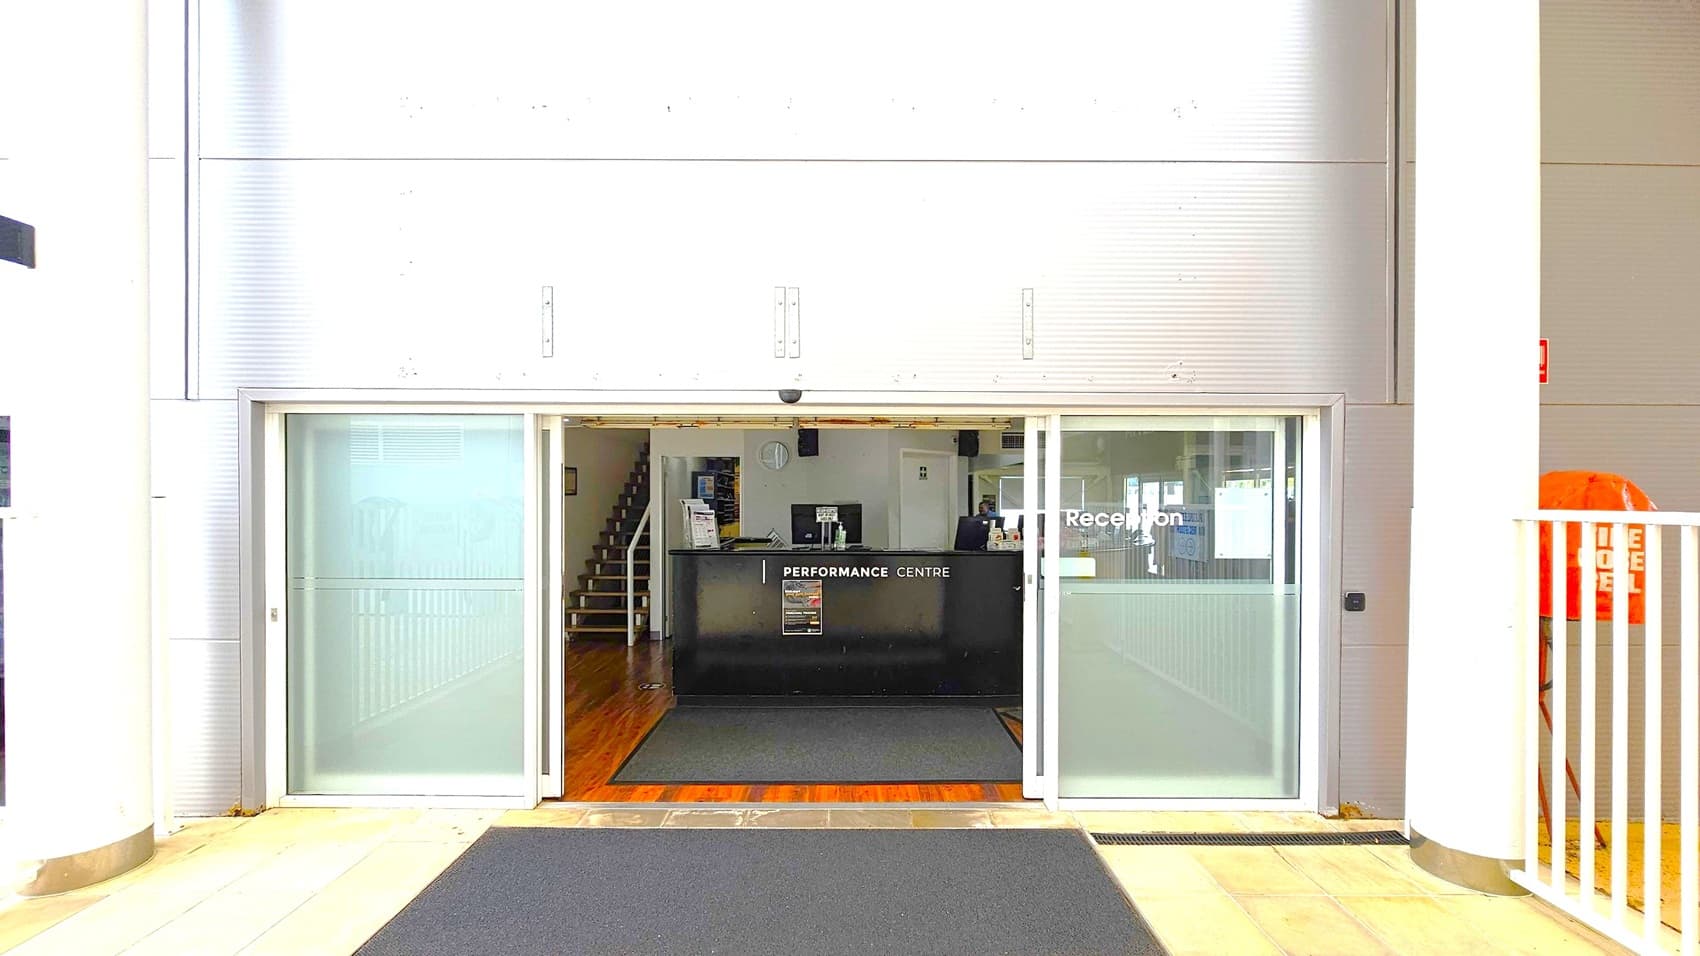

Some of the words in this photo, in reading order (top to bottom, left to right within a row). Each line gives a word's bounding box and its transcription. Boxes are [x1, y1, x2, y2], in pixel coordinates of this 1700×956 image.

[1578, 548, 1645, 571] OE
[783, 566, 889, 578] PERFORMANCE
[896, 566, 950, 578] CENTRE
[1580, 571, 1642, 593] EL
